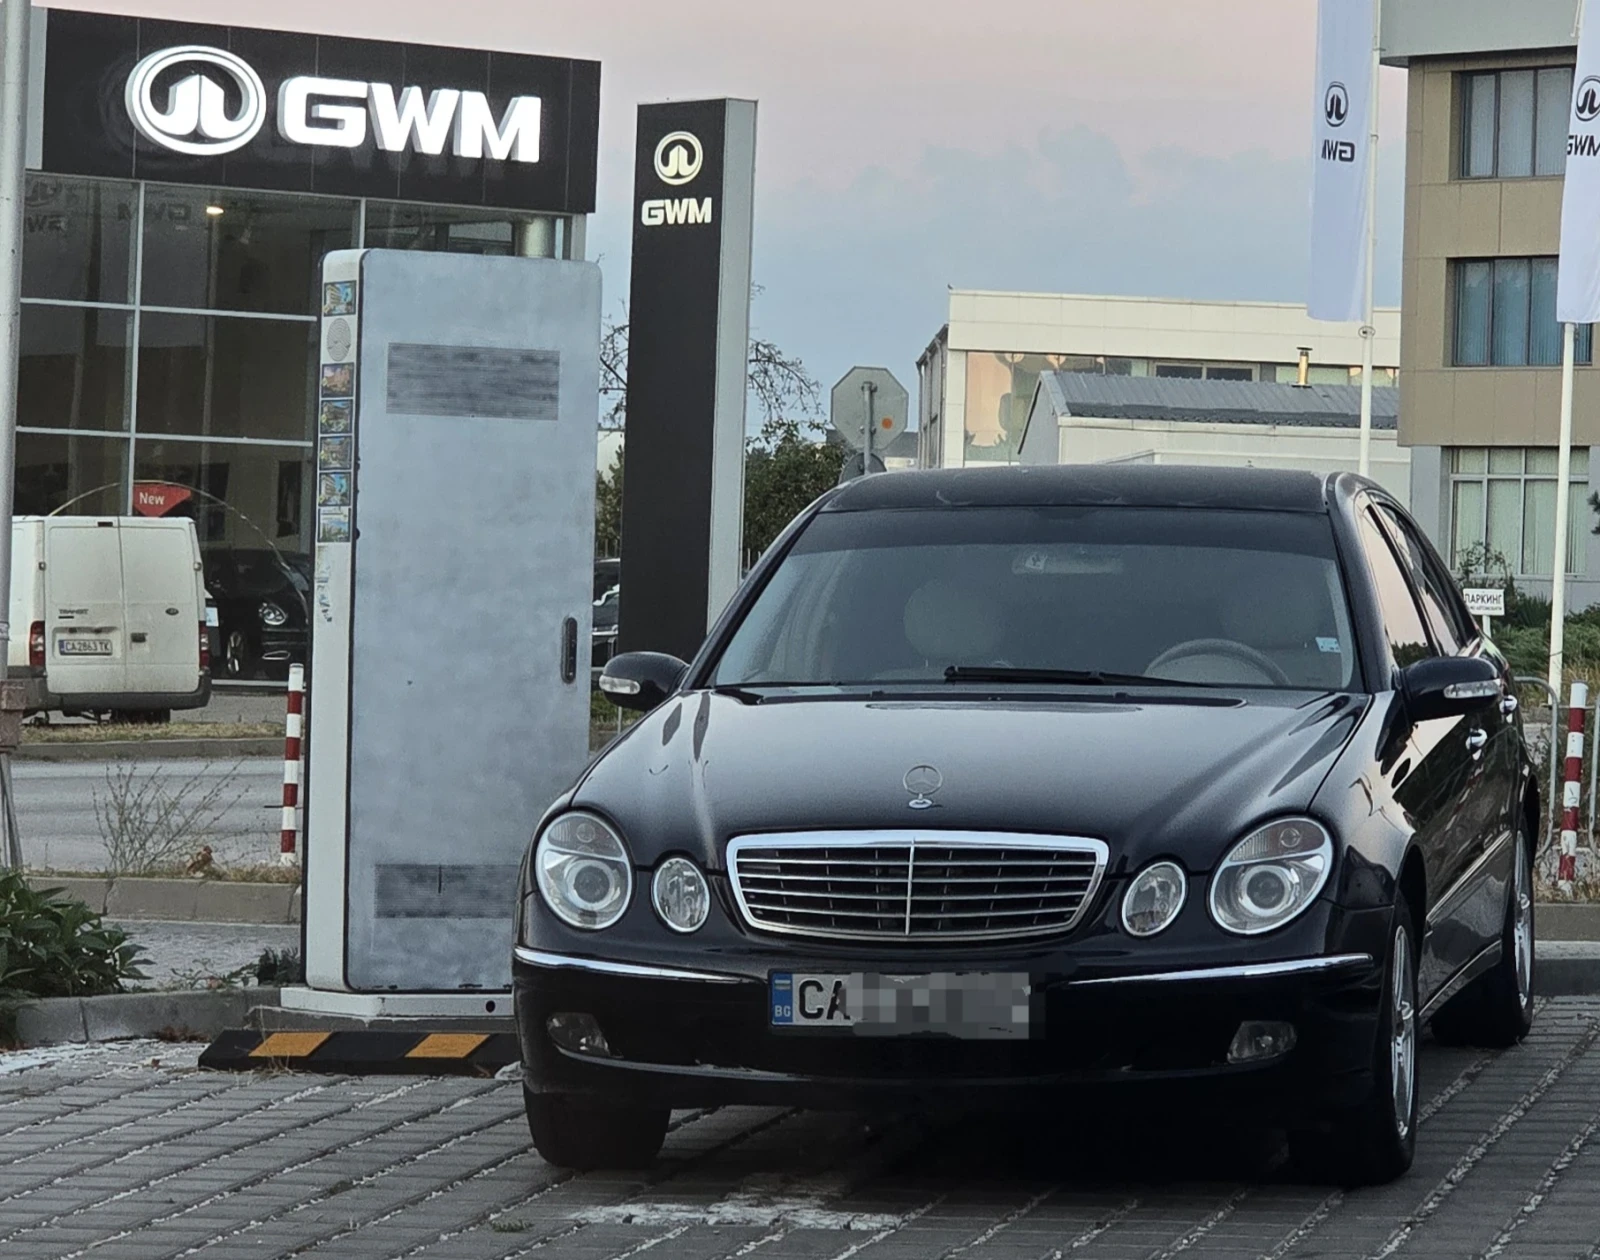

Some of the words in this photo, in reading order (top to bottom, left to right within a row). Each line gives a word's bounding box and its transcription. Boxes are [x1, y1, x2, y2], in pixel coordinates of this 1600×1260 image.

[277, 75, 542, 163] GWM
[641, 197, 712, 226] GWM
[139, 491, 165, 505] New
[774, 1005, 791, 1018] BG
